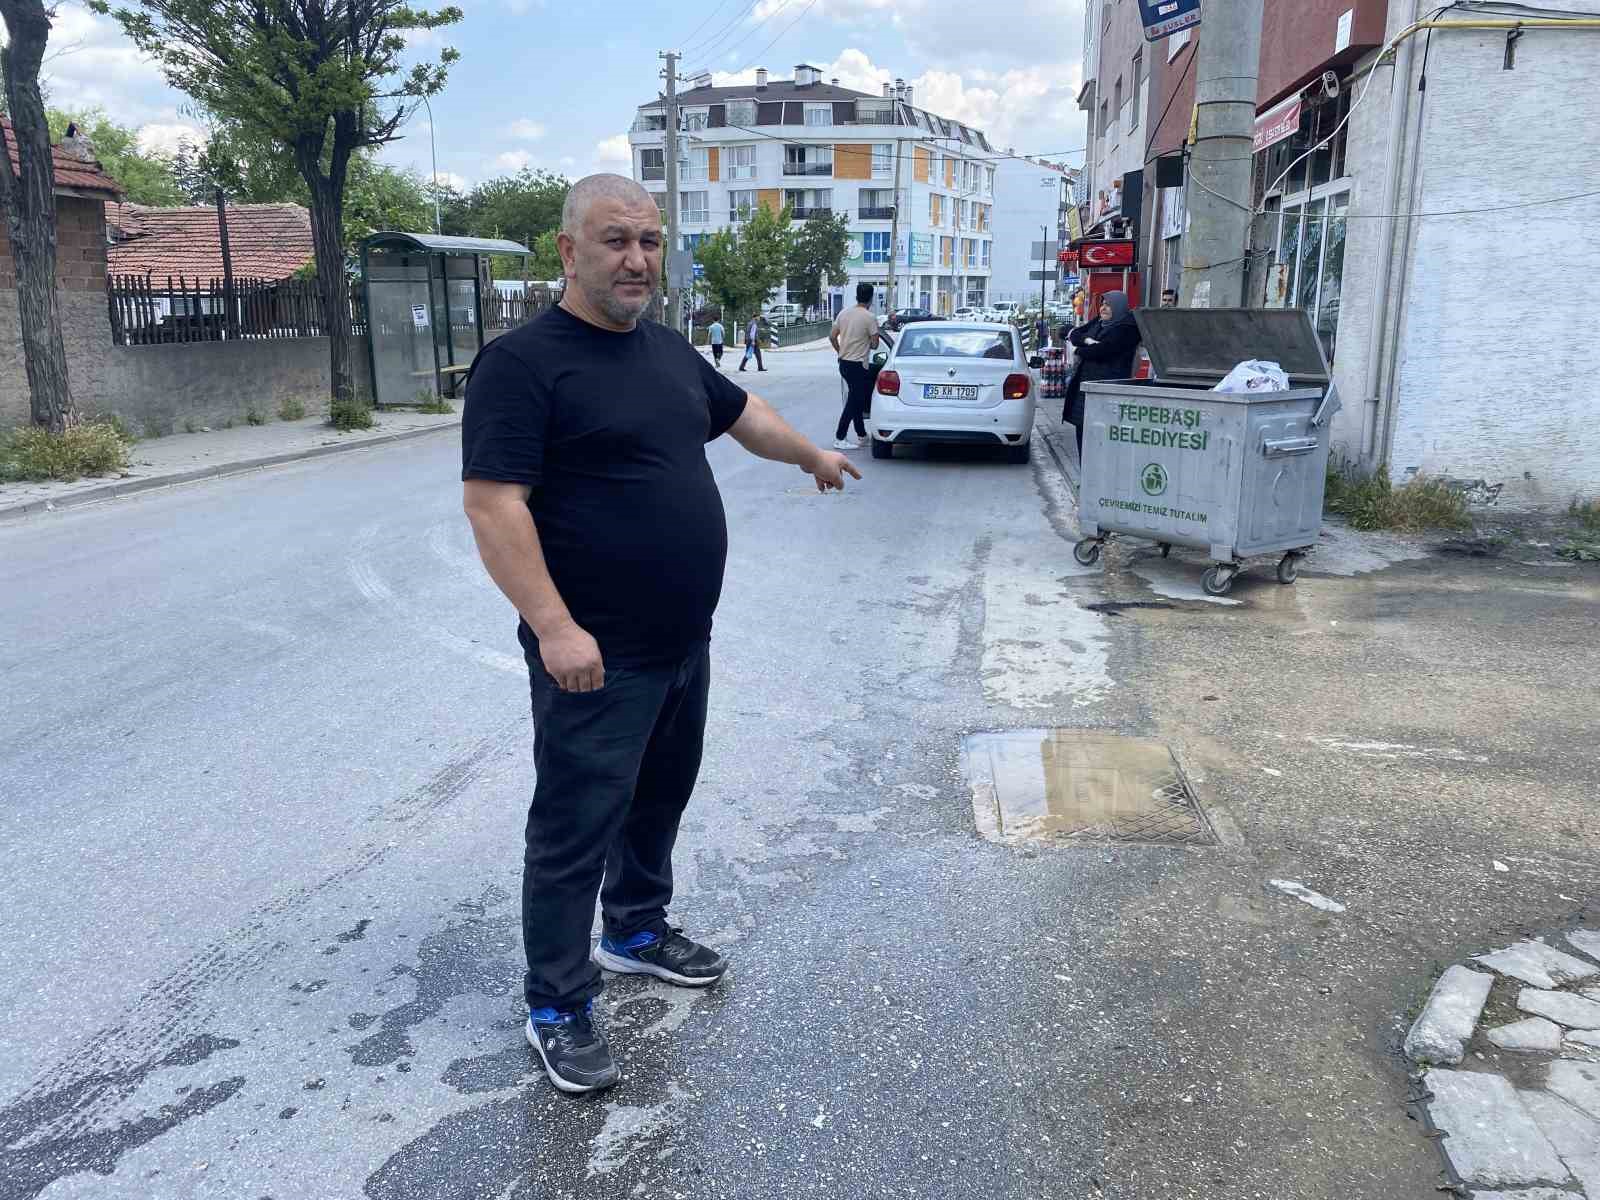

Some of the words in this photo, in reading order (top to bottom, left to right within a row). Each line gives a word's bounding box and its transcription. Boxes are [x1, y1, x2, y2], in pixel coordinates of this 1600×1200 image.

[929, 386, 940, 396] 35
[942, 386, 953, 396] KH
[956, 387, 977, 397] 1709
[1118, 403, 1201, 430] TEPEBAŞI
[1109, 424, 1209, 451] BELEDİYESİ
[1169, 508, 1208, 524] TUTALIM
